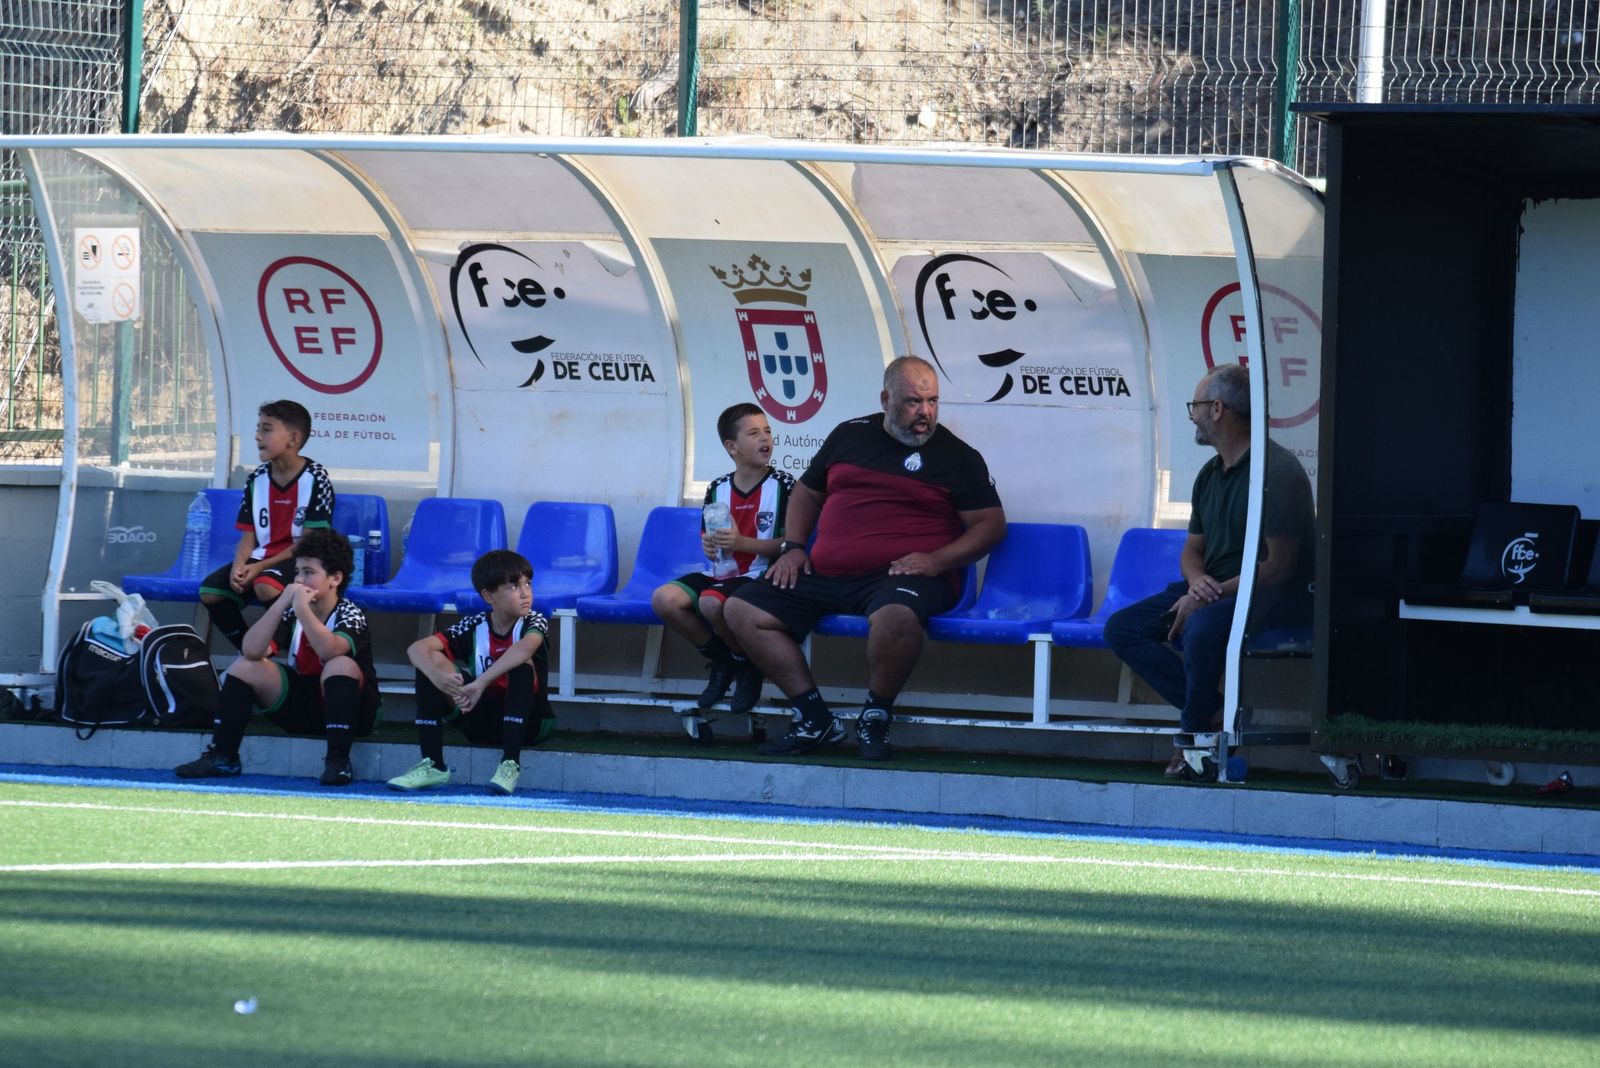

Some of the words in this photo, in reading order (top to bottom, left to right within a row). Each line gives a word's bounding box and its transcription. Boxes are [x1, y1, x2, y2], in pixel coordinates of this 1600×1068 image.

[551, 353, 601, 361] FEDERACIÓN
[603, 354, 614, 362] DE
[616, 353, 647, 362] FÚTBOL
[553, 361, 581, 380] DE
[588, 362, 655, 382] CEUTA
[1020, 365, 1074, 375] FEDERACIÓN
[1075, 367, 1088, 376] DE
[1089, 366, 1122, 376] FÚTBOL
[1022, 375, 1052, 394] DE
[1059, 375, 1131, 397] CEUTA
[314, 412, 386, 422] FEDERACIÓN
[310, 430, 330, 438] OLA
[335, 430, 349, 439] DE
[353, 428, 397, 440] FÚTBOL
[784, 434, 825, 447] Autóno
[783, 454, 811, 470] Ceu
[259, 508, 269, 528] 6
